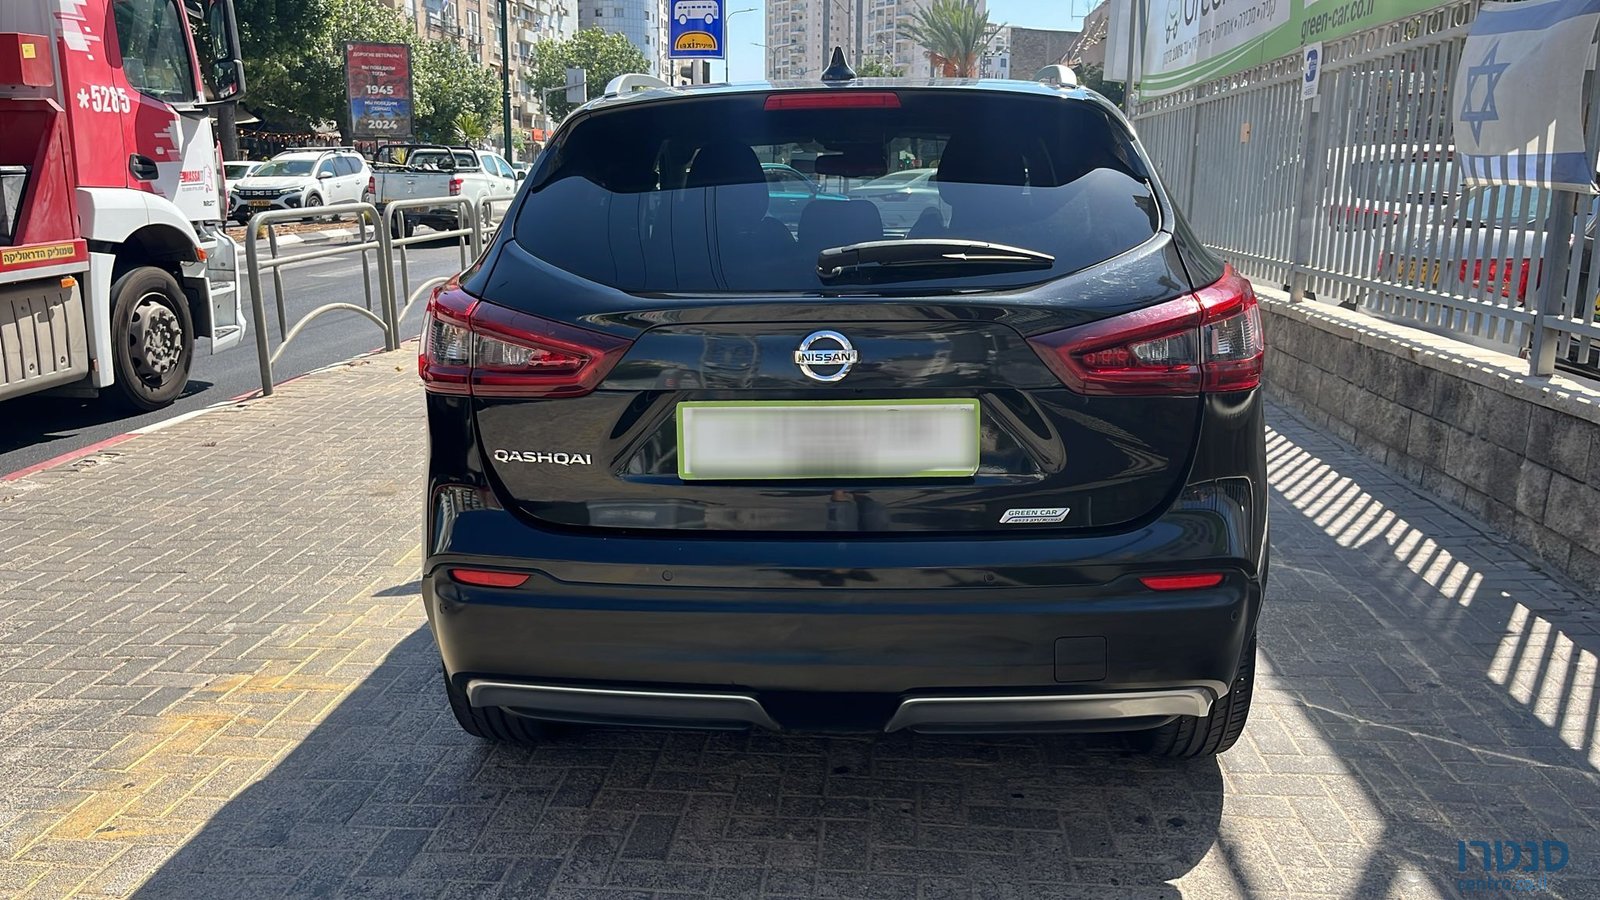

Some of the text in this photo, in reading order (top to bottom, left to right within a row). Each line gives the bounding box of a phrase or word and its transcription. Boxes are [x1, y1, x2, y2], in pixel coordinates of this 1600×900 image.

[366, 85, 393, 94] 1945
[367, 120, 398, 129] 2024
[3, 246, 73, 263] שמוליק הדראוליקה
[802, 353, 851, 361] NISSAN
[494, 449, 592, 466] QASHQAI
